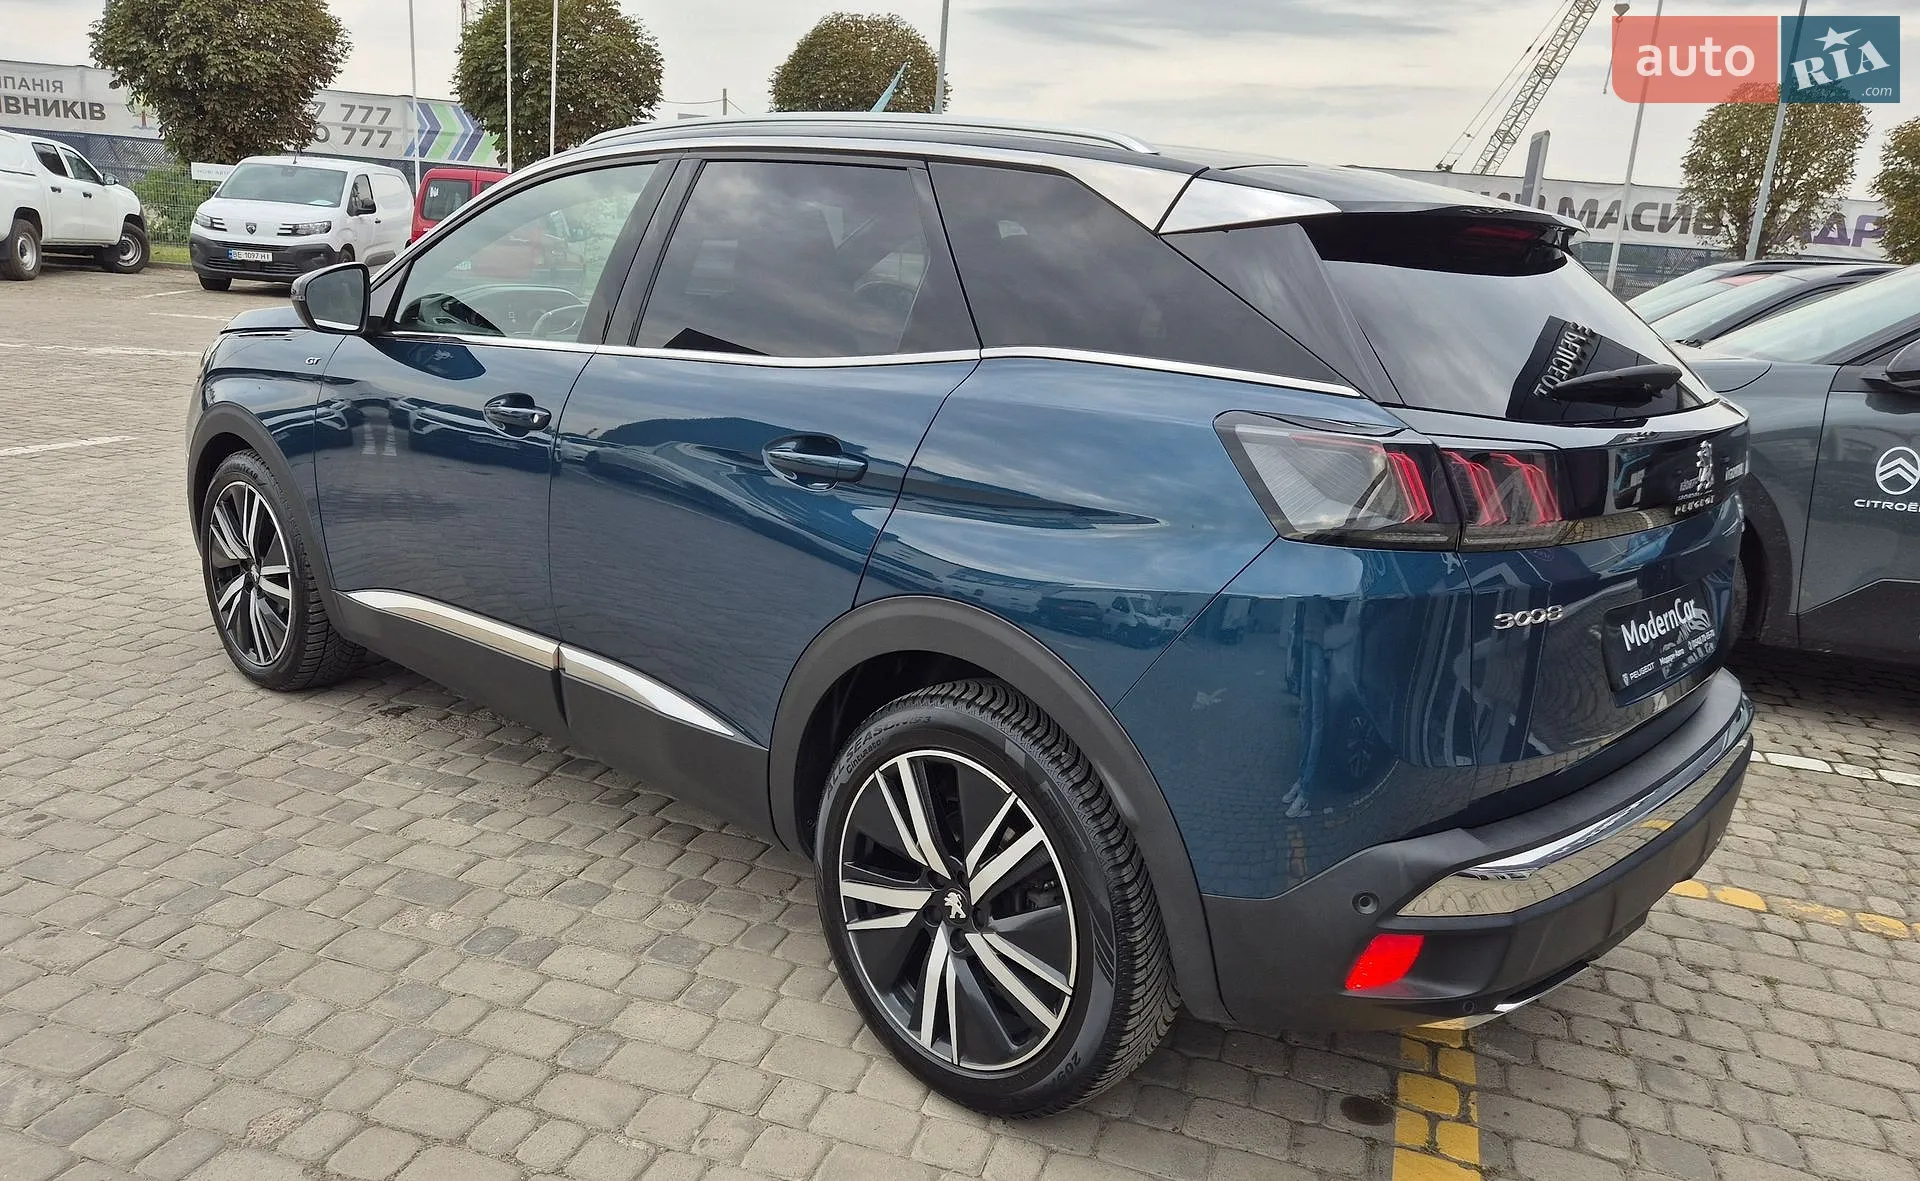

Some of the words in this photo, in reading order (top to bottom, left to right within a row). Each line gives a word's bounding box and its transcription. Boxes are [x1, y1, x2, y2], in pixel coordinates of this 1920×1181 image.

[0, 76, 64, 94] ПАНІЯ
[340, 103, 392, 126] 777
[341, 126, 393, 149] 777
[305, 357, 321, 365] GT
[1854, 499, 1920, 513] CITROË
[1494, 604, 1564, 630] 3008
[1621, 598, 1696, 652] ModernCar
